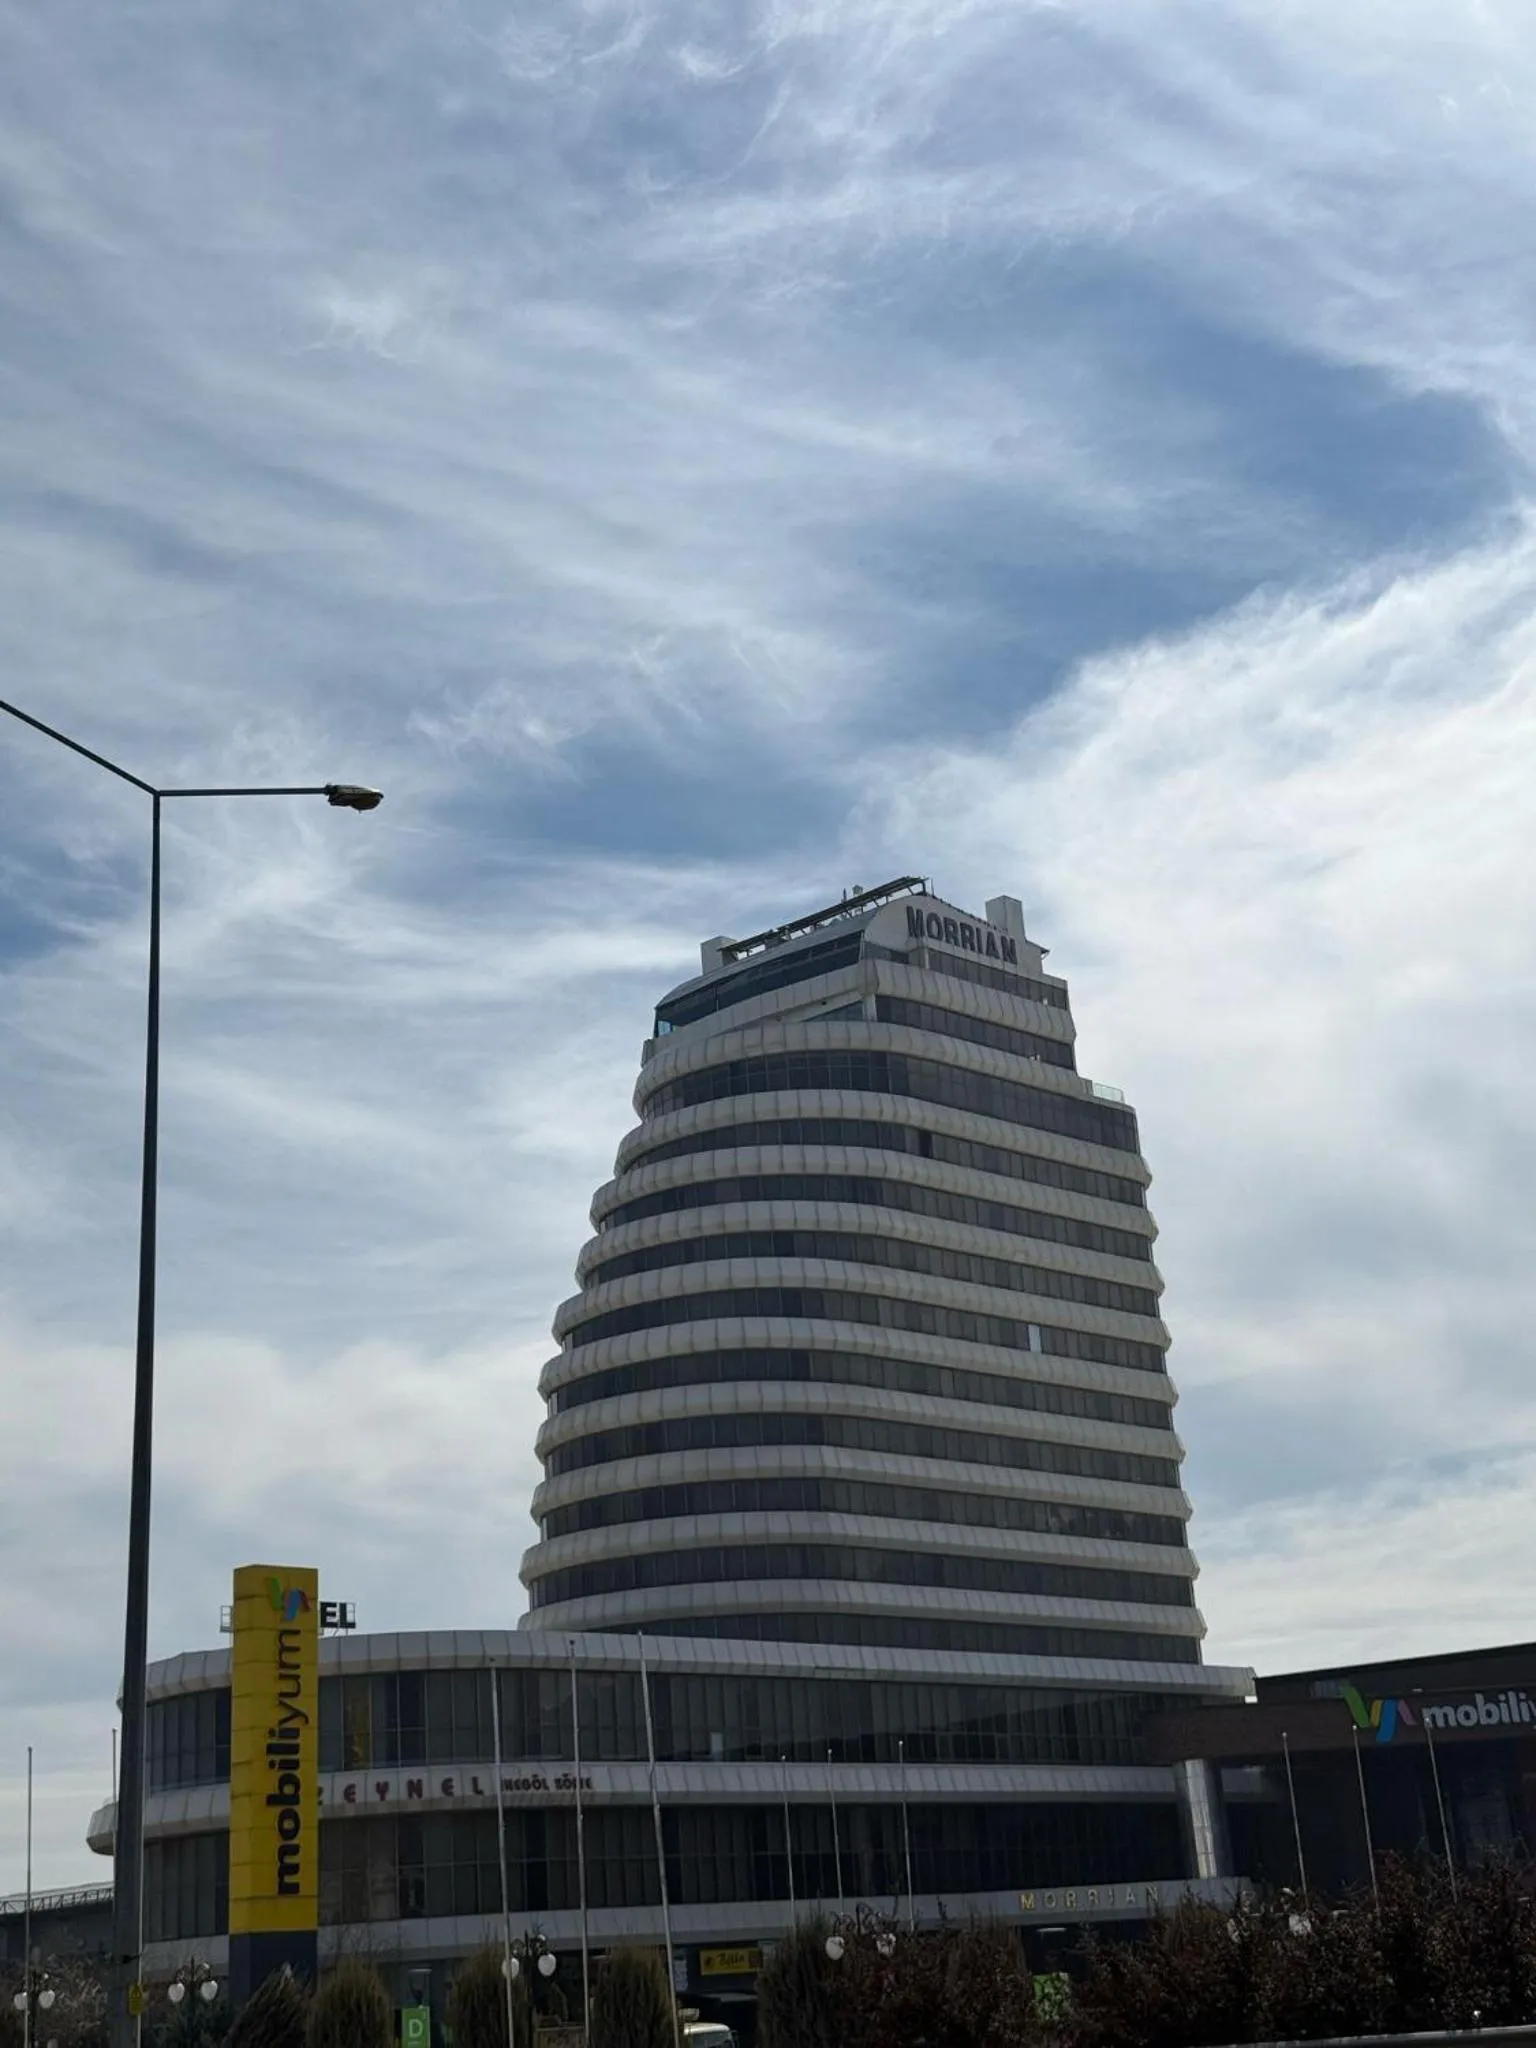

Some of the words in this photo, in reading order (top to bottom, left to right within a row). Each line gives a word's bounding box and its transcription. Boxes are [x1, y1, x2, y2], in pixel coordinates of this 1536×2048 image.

[906, 906, 1018, 965] MORRIAN
[266, 1628, 309, 1896] mobiliyum
[1018, 1885, 1161, 1912] MORRIAN
